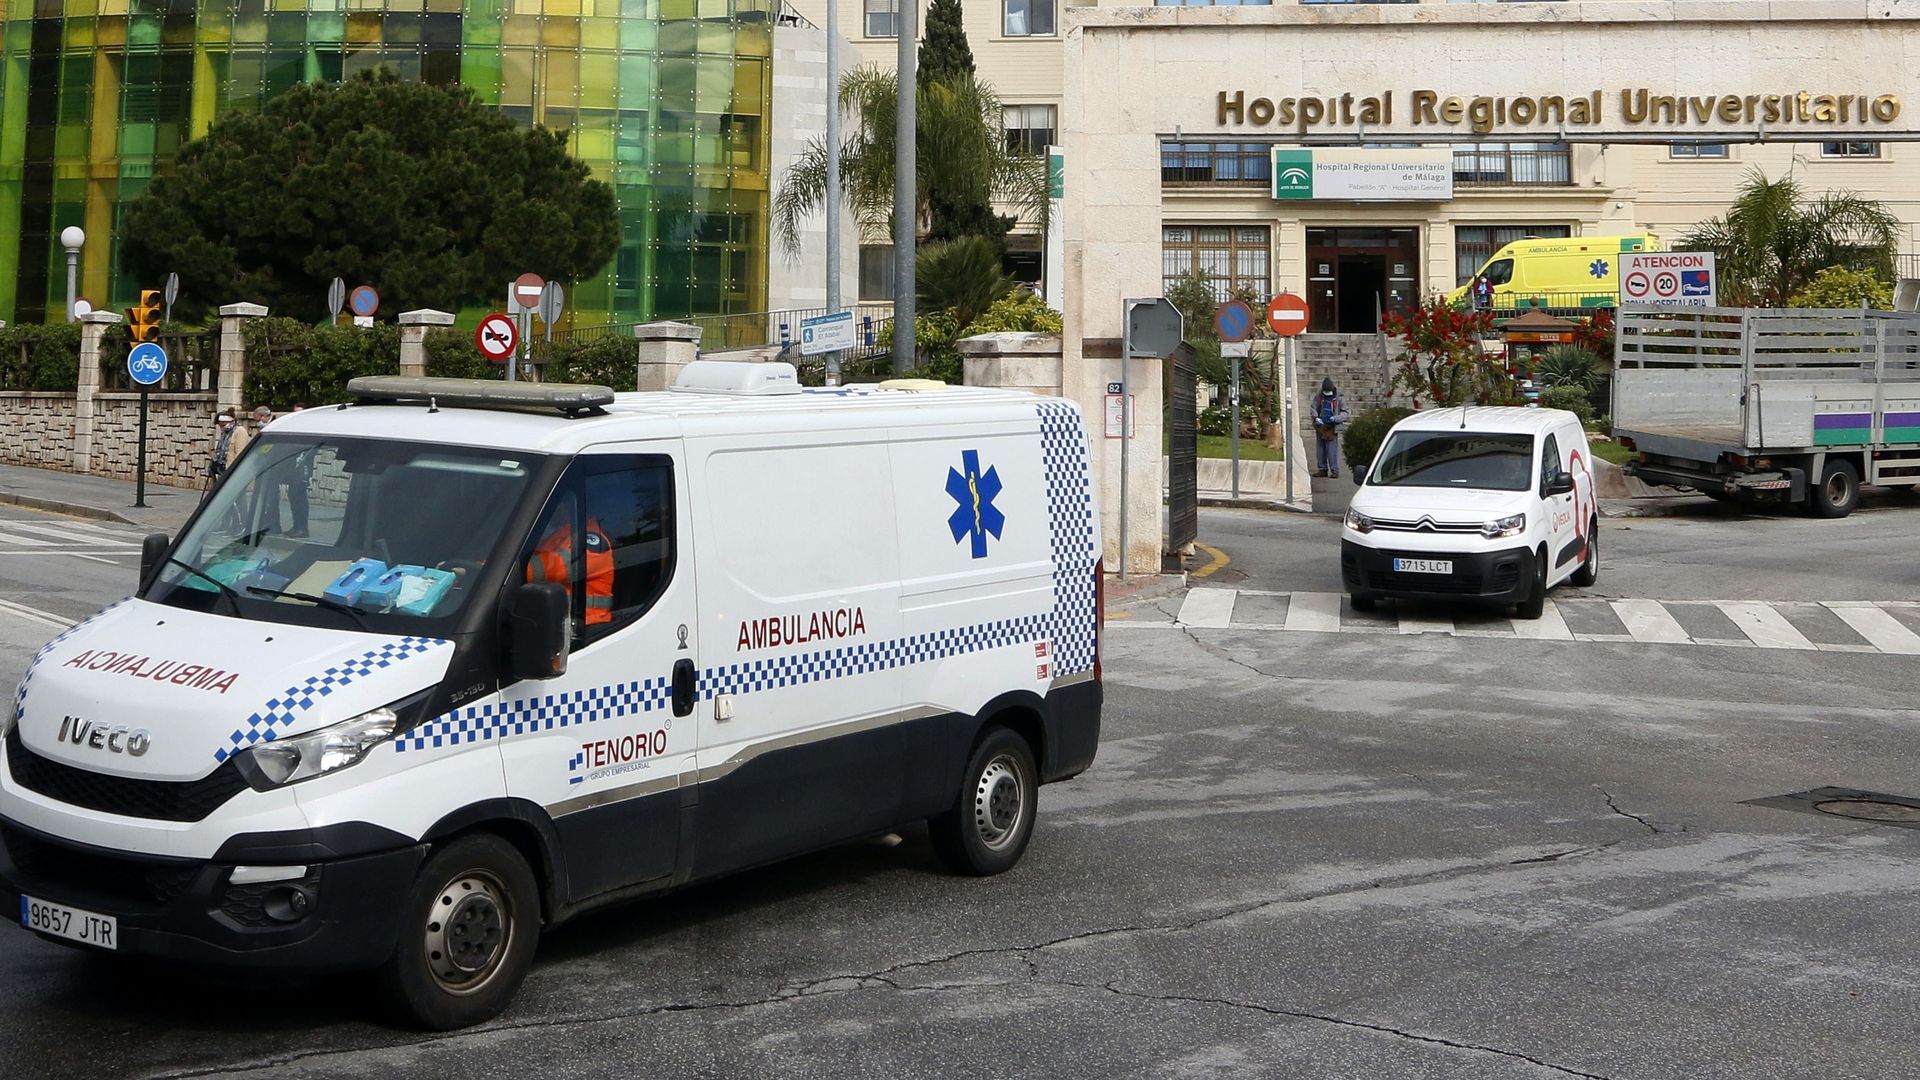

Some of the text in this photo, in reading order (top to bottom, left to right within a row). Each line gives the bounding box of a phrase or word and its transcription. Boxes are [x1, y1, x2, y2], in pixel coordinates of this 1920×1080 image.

[1218, 88, 1900, 133] Hospital Regional Universitario
[1316, 163, 1445, 173] Hospital Regional Universitario
[1402, 173, 1445, 182] de Málaga
[1392, 184, 1420, 192] Hospital
[1632, 256, 1704, 268] ATENCION
[1659, 278, 1673, 289] 20
[1108, 383, 1120, 393] 82
[1400, 560, 1450, 572] 3715 LCT
[737, 606, 866, 652] AMBULANCIA
[57, 715, 151, 757] IVECO
[582, 729, 667, 769] TENORIO
[590, 761, 651, 781] GRUPO EMPRESARIAL
[31, 903, 112, 945] 9657 JTR
